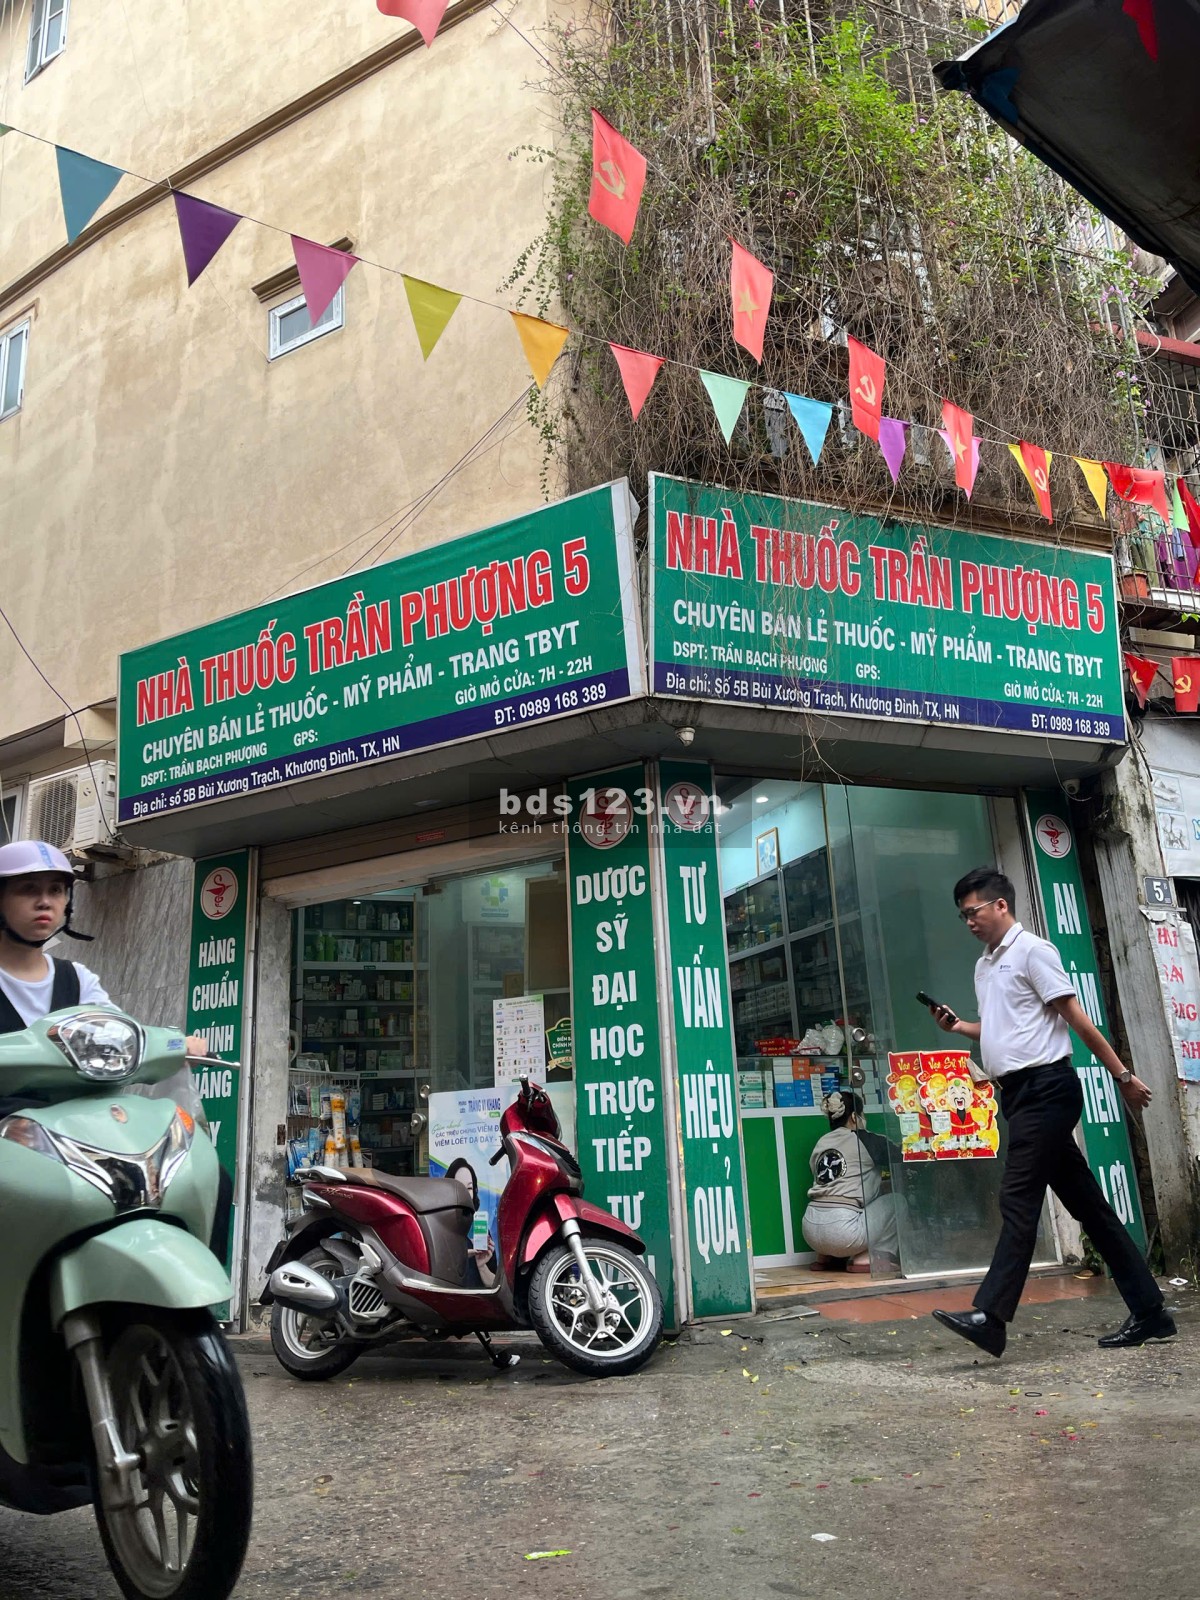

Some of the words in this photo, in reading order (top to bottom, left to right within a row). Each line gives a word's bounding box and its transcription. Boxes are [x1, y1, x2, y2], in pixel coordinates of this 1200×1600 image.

[666, 507, 744, 580] NHÀ
[750, 519, 861, 597] THUỐC
[868, 535, 954, 610] TRẦN
[959, 560, 1081, 636] PHƯỢNG
[1085, 582, 1105, 634] 5
[136, 656, 194, 727] NHÀ
[200, 619, 297, 706] THUỐC
[303, 590, 392, 675] TRẦN
[400, 549, 554, 647] PHƯỢNG
[562, 536, 590, 597] 5
[673, 599, 755, 634] CHUYÊN
[761, 607, 800, 640] BÁN
[807, 609, 827, 642] LẺ
[833, 616, 895, 651] THUỐC
[910, 627, 937, 656] MỸ
[943, 625, 992, 664] PHẨM
[1005, 644, 1061, 673] TRANG
[1065, 652, 1103, 679] TBYT
[455, 682, 477, 705] GIỜ
[480, 674, 500, 699] MỞ
[504, 667, 535, 693] CỬA:
[538, 665, 556, 684] 7H
[566, 655, 593, 676] 22H
[673, 641, 708, 660] DSPT:
[711, 641, 743, 664] TRẦN
[745, 650, 777, 670] BẠCH
[780, 653, 827, 676] PHƯỢNG
[856, 663, 880, 680] GPS:
[143, 726, 204, 764] CHUYÊN
[208, 716, 241, 746] BÁN
[246, 702, 265, 736] LẺ
[269, 685, 328, 729] THUỐC
[343, 674, 371, 708] MỸ
[377, 653, 433, 699] PHẨM
[449, 638, 520, 679] TRANG
[525, 620, 580, 657] TBYT
[494, 706, 516, 725] ĐT:
[519, 697, 550, 718] 0989
[554, 689, 578, 710] 168
[582, 682, 607, 703] 389
[666, 672, 685, 694] Địa
[689, 673, 711, 693] chỉ:
[714, 675, 731, 695] Số
[733, 680, 749, 697] 5B
[752, 681, 771, 699] Bùi
[774, 684, 810, 707] Xương
[813, 688, 847, 710] Trạch,
[850, 693, 892, 716] Khương
[894, 697, 922, 717] Đình,
[925, 700, 942, 720] TX,
[944, 704, 960, 720] HN
[1004, 679, 1021, 698] GIỜ
[1024, 681, 1040, 701] MỞ
[1042, 682, 1064, 704] CỬA:
[1067, 691, 1079, 705] 7H
[1086, 694, 1103, 708] 22H
[293, 729, 319, 747] GPS:
[1032, 713, 1048, 730] ĐT:
[1050, 716, 1072, 732] 0989
[1075, 718, 1091, 735] 168
[1094, 720, 1110, 736] 389
[133, 801, 148, 817] Địa
[150, 792, 167, 813] chỉ:
[169, 788, 181, 807] số
[183, 789, 196, 803] 5B
[198, 785, 215, 800] Bùi
[216, 777, 249, 797] Xương
[250, 767, 283, 788] Trạch,
[285, 758, 327, 776] Khương
[329, 749, 358, 766] Đình,
[360, 741, 379, 758] TX,
[382, 735, 400, 753] HN
[141, 769, 167, 788] DSPT:
[169, 758, 194, 780] TRẦN
[196, 752, 223, 775] BẠCH
[225, 742, 267, 764] PHƯỢNG
[576, 865, 646, 906] DƯỢC
[679, 861, 707, 925] TƯ
[1053, 883, 1082, 934] AN
[198, 936, 236, 968] HÀNG
[596, 912, 629, 953] SỸ
[192, 971, 238, 1012] CHUẨN
[592, 970, 637, 1011] ĐẠI
[677, 944, 724, 1028] VẤN
[1066, 961, 1103, 1026] ÂM
[590, 1023, 645, 1066] HỌC
[584, 1076, 655, 1121] TRỰC
[682, 1059, 733, 1154] HIỆU
[1076, 1053, 1120, 1137] TIỆN
[592, 1124, 651, 1172] TIẾP
[607, 1191, 645, 1230] TƯ
[694, 1156, 741, 1265] QUẢ
